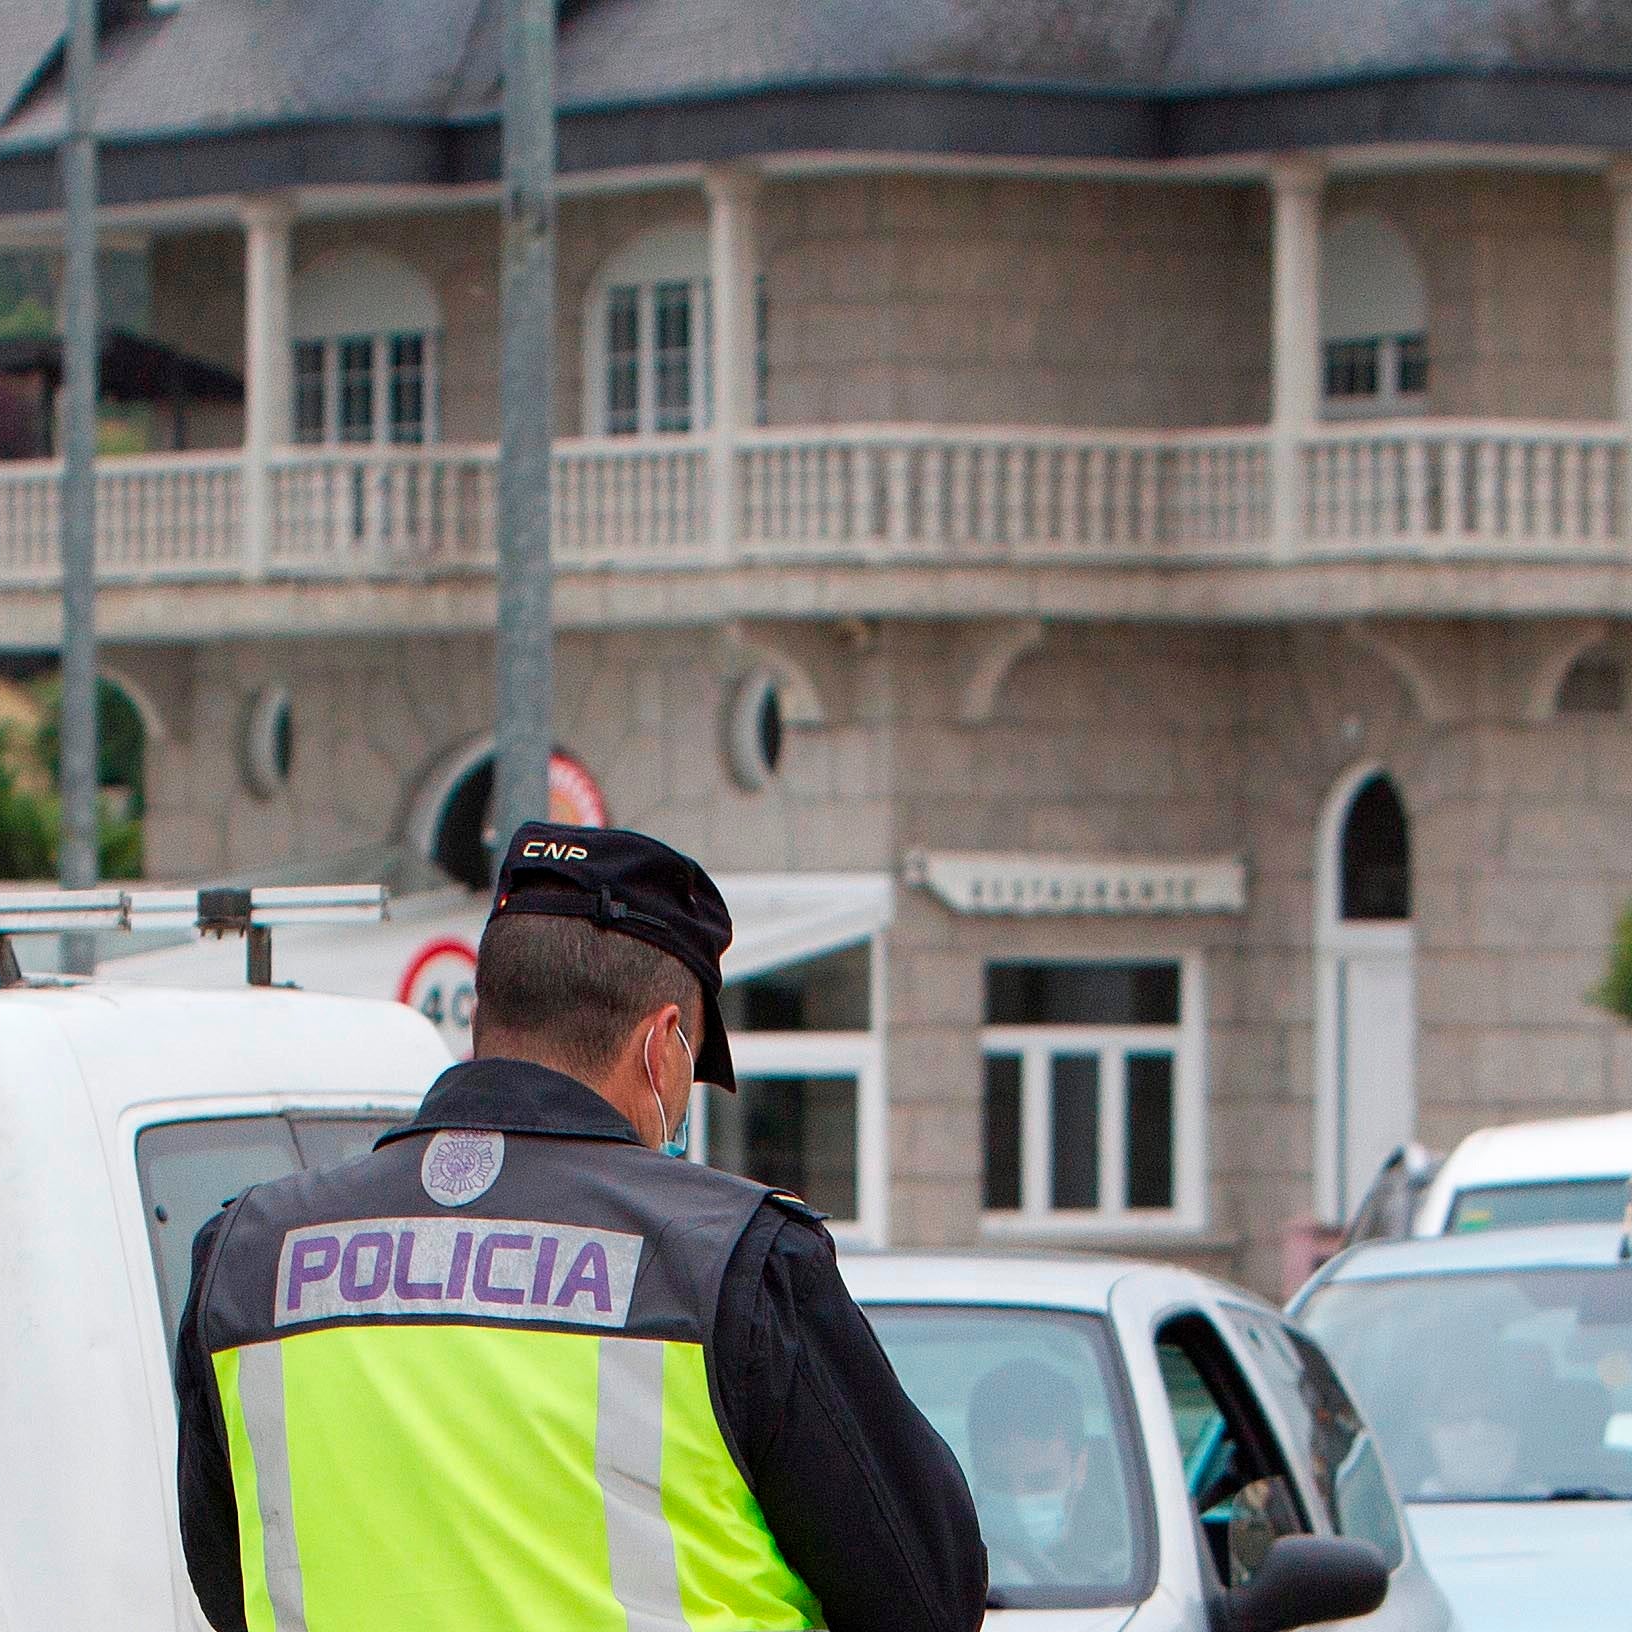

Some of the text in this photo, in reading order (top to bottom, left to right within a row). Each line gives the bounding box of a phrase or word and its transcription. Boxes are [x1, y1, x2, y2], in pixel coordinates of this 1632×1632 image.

[523, 841, 589, 861] CNP
[421, 984, 475, 1027] 40
[286, 1231, 613, 1312] POLICIA
